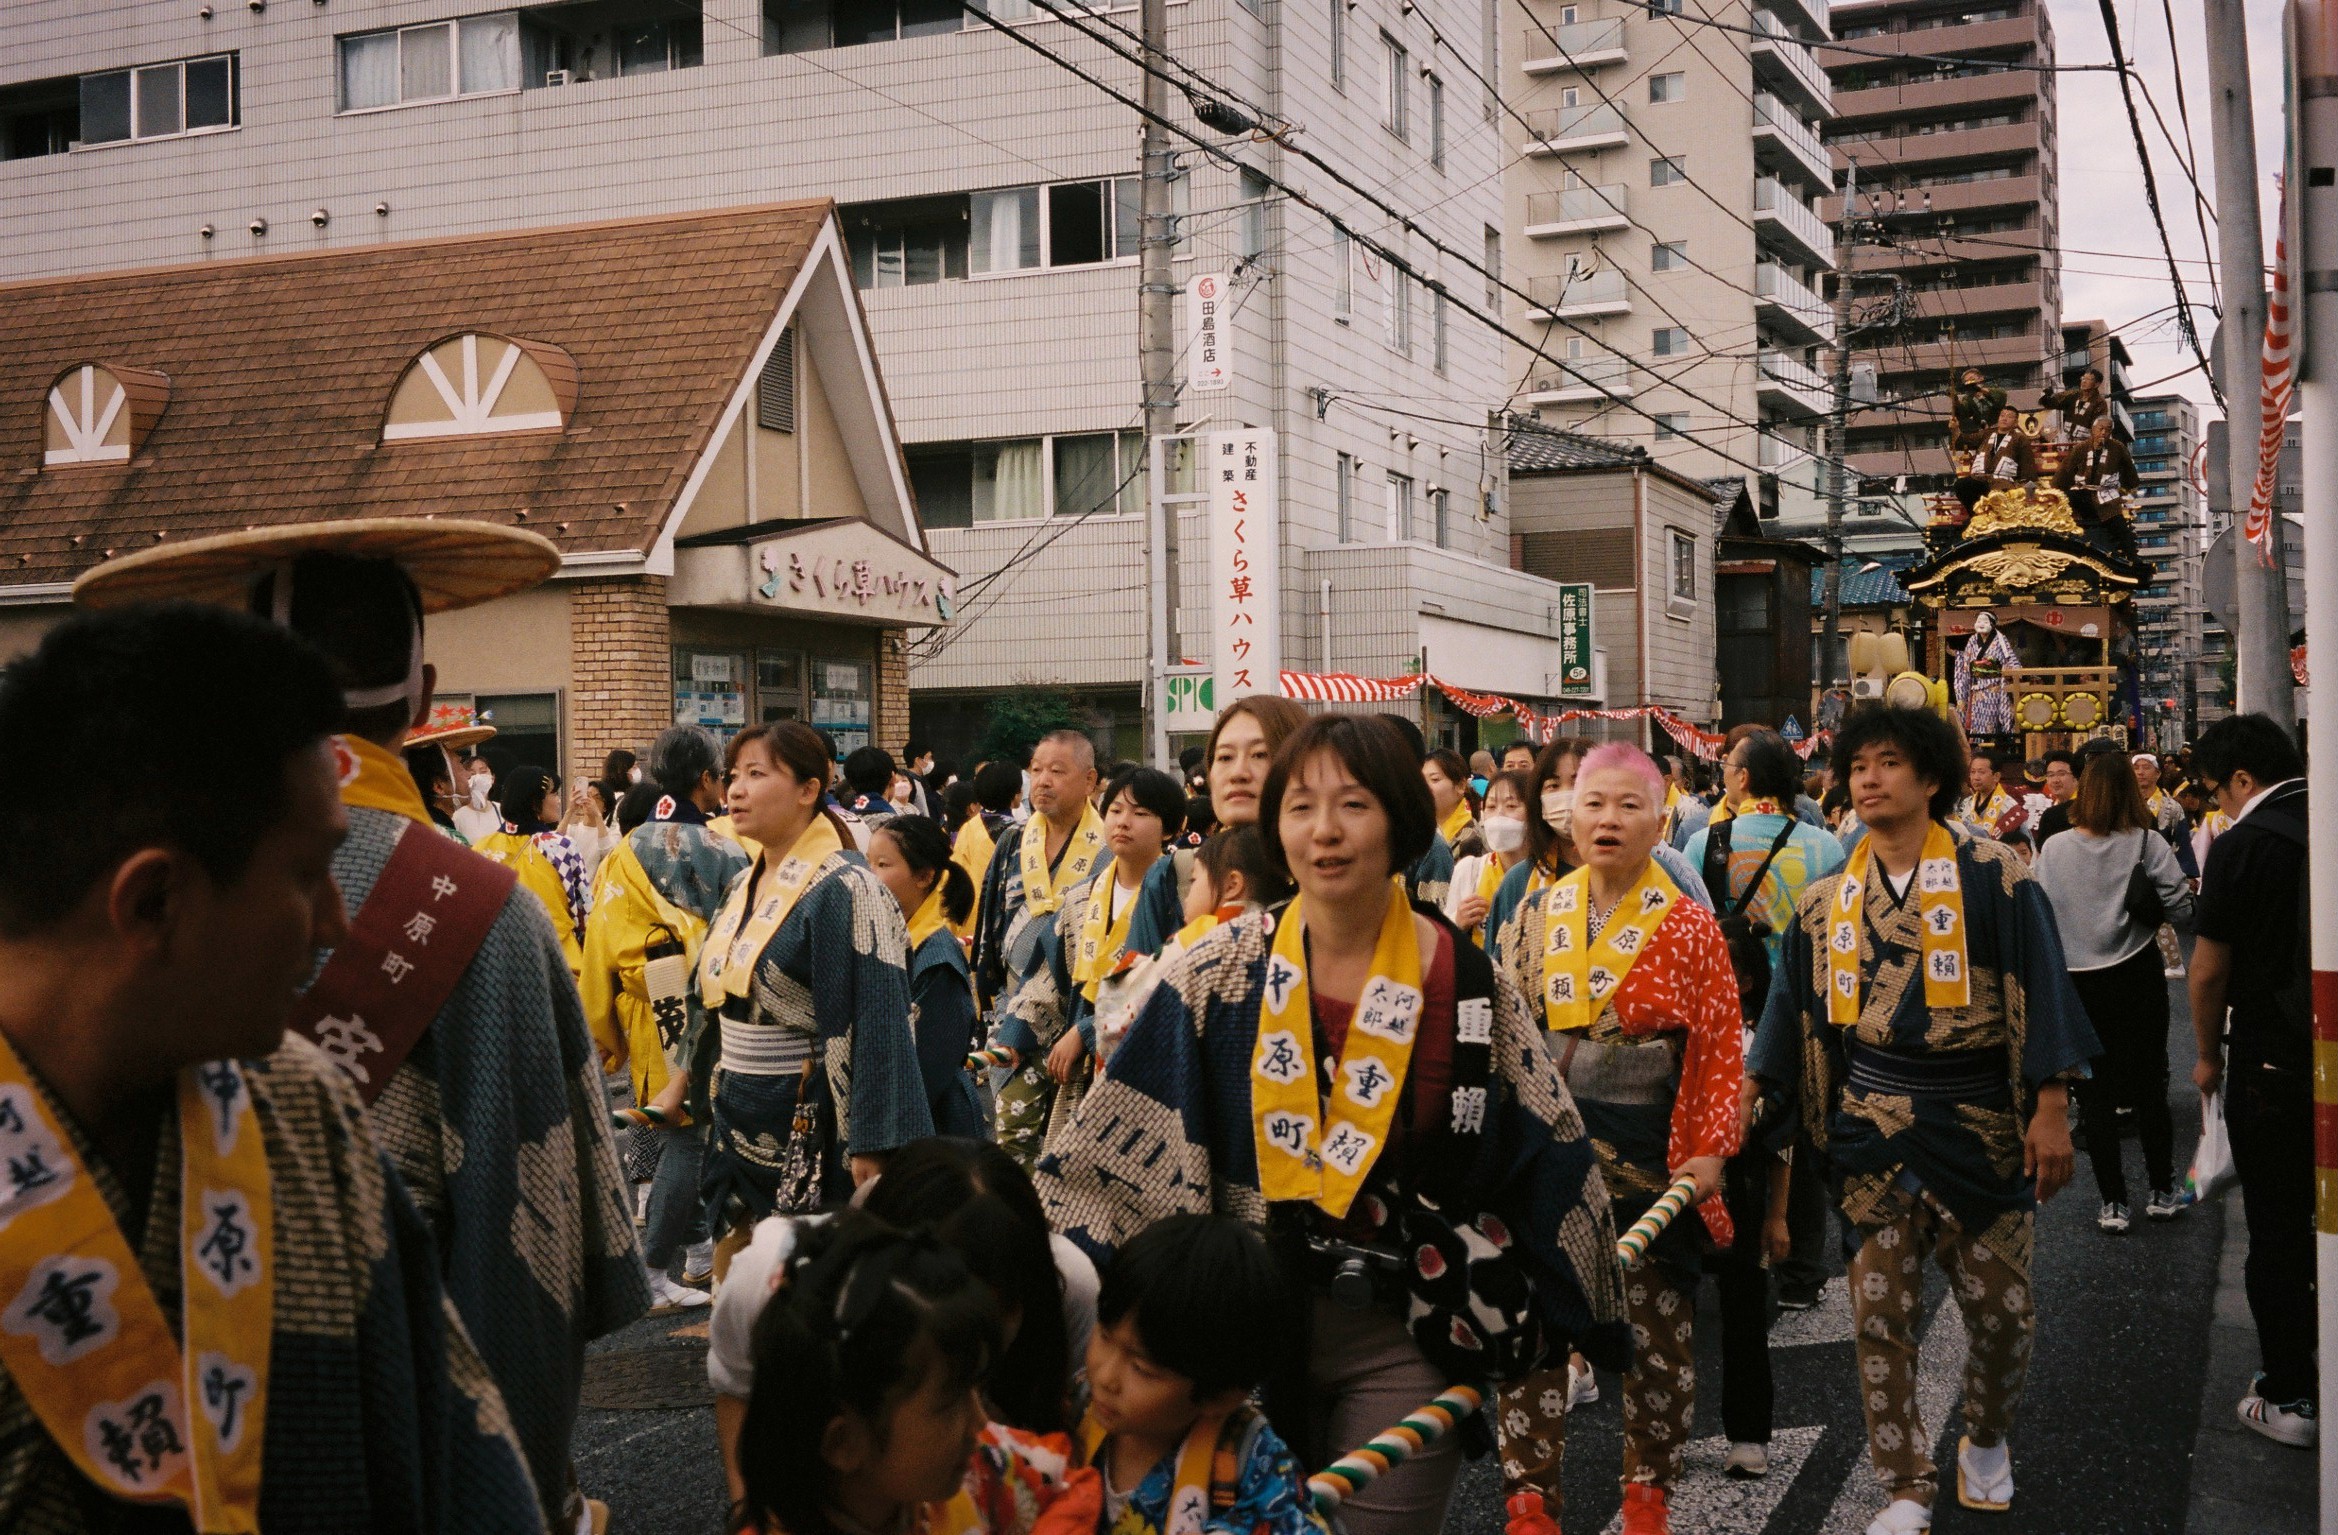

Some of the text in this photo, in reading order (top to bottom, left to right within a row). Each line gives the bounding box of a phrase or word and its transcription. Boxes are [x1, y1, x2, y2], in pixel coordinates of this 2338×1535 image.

[1202, 301, 1216, 363] 田島酒店
[1222, 443, 1234, 482] 建築
[1245, 441, 1257, 481] 不動産
[789, 552, 930, 609] さくら草ハウス
[1229, 490, 1254, 688] さくら草ハウス
[1563, 593, 1577, 664] 佐原事務所
[1573, 669, 1584, 678] 5F
[380, 875, 457, 984] 中原町
[1263, 963, 1302, 1150] 中原町
